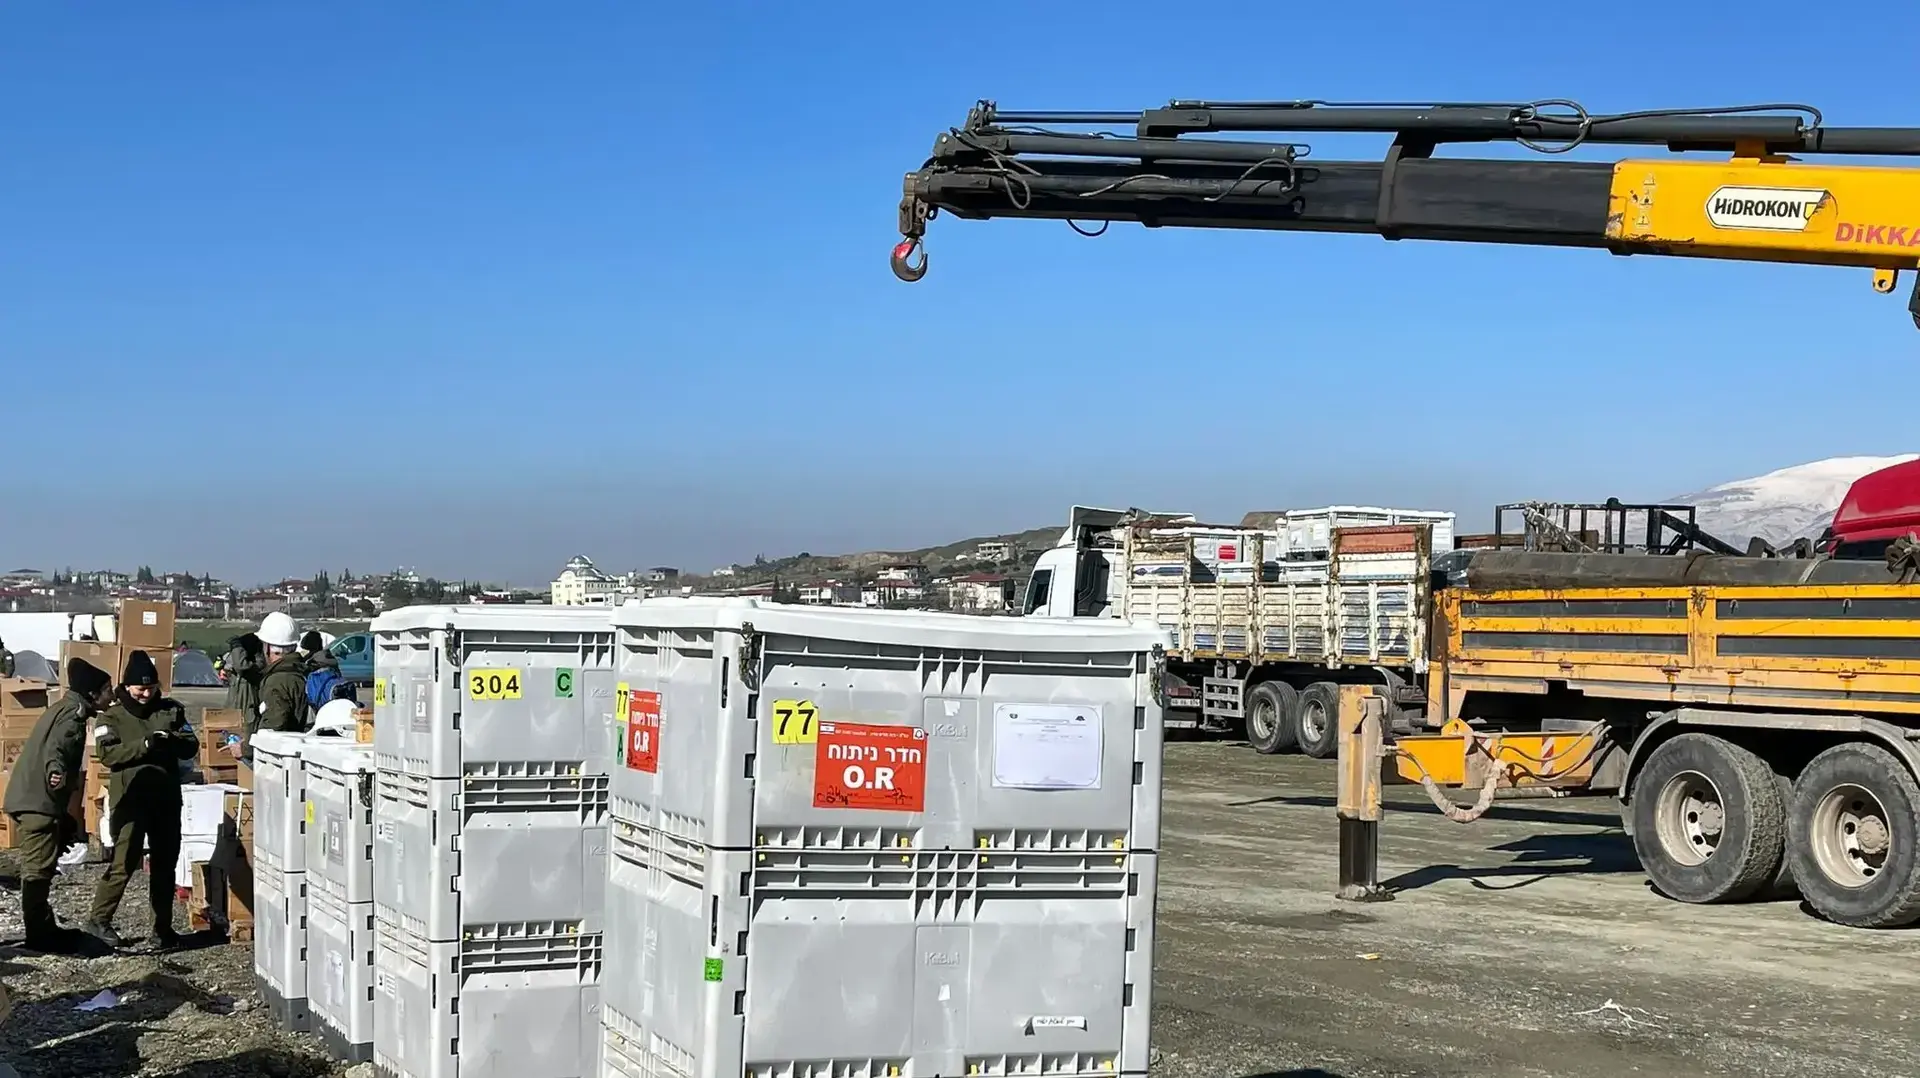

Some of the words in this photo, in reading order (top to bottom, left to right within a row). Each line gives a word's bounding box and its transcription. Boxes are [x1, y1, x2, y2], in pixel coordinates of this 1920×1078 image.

[472, 675, 519, 694] 304
[557, 673, 570, 692] C
[618, 690, 628, 714] 77
[776, 709, 814, 735] 77
[617, 733, 624, 758] A
[828, 744, 878, 761] ניתוח
[885, 746, 921, 764] חדר
[843, 765, 895, 790] O.R
